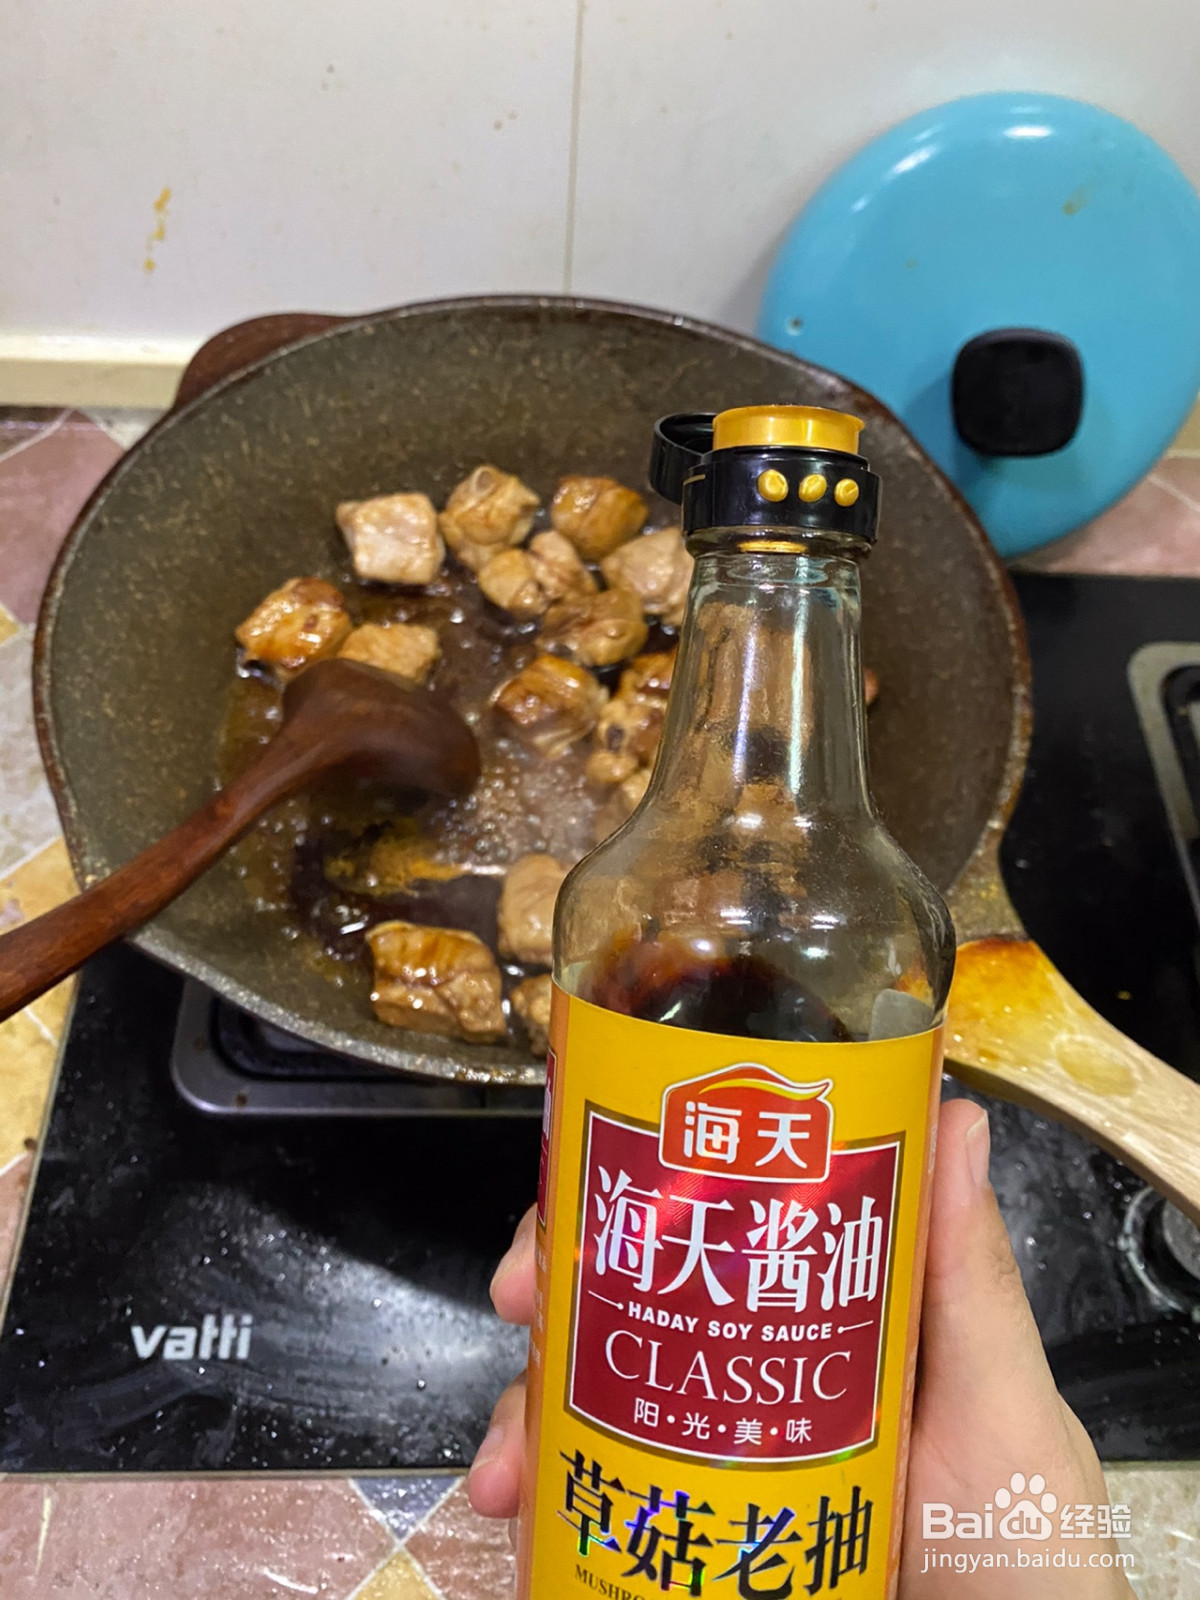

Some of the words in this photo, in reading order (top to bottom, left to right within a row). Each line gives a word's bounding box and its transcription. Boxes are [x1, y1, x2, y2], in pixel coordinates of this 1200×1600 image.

[683, 1101, 812, 1169] 海天
[593, 1165, 884, 1313] 海天酱油
[130, 1313, 253, 1360] vatti
[628, 1301, 699, 1333] HADAY
[707, 1320, 753, 1340] SOY
[761, 1322, 833, 1342] SAUCE
[604, 1329, 851, 1405] CLASSIC
[557, 1449, 875, 1600] 草菇老抽
